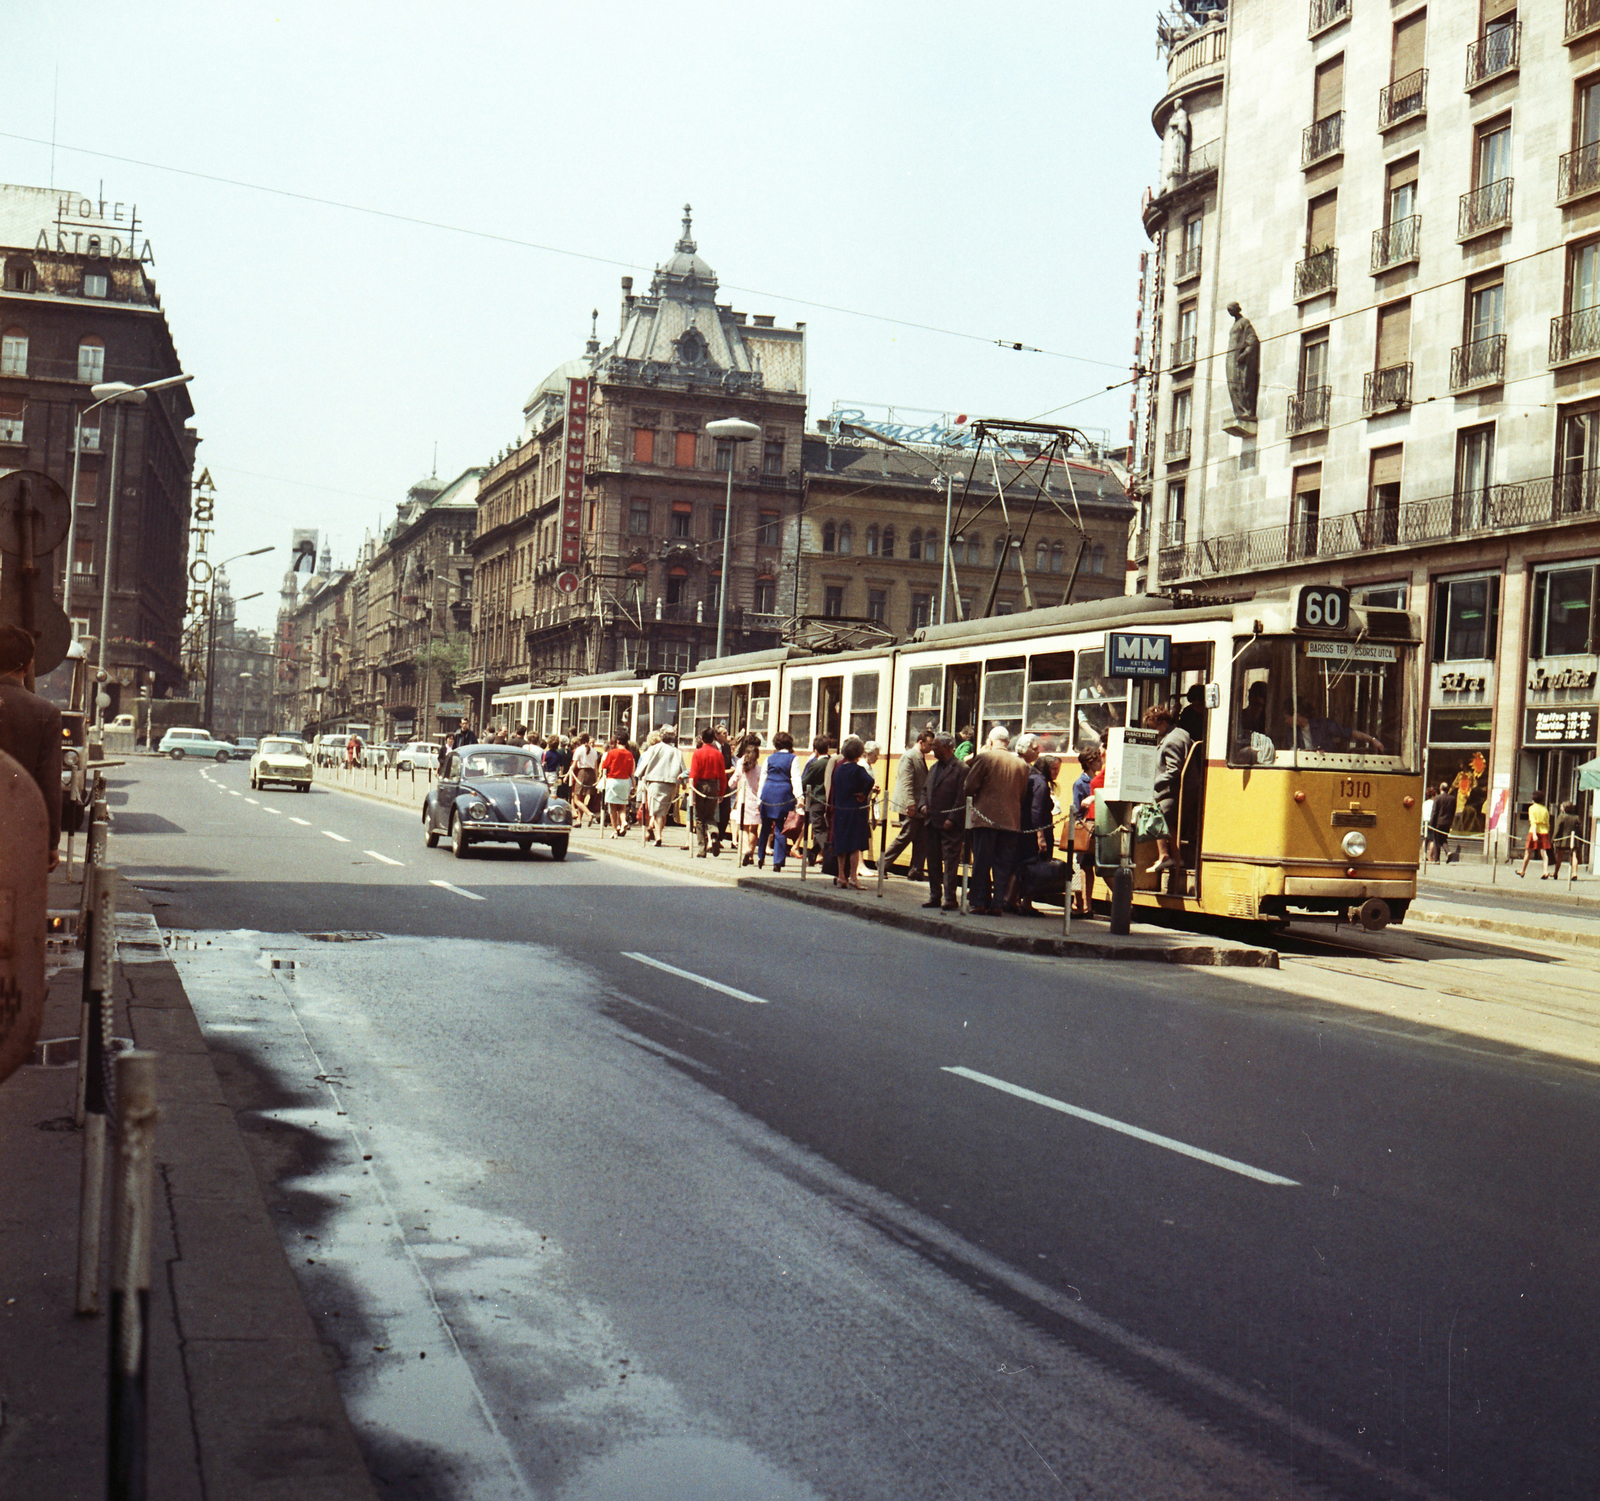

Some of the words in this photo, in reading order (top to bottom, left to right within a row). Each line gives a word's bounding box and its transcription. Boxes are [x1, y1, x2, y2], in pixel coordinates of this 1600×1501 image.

[34, 229, 155, 267] ASTORIA
[1305, 591, 1341, 626] 60
[1118, 636, 1165, 660] MM
[1309, 643, 1334, 653] BAROSS
[662, 676, 676, 690] 19
[1339, 779, 1371, 799] 1310
